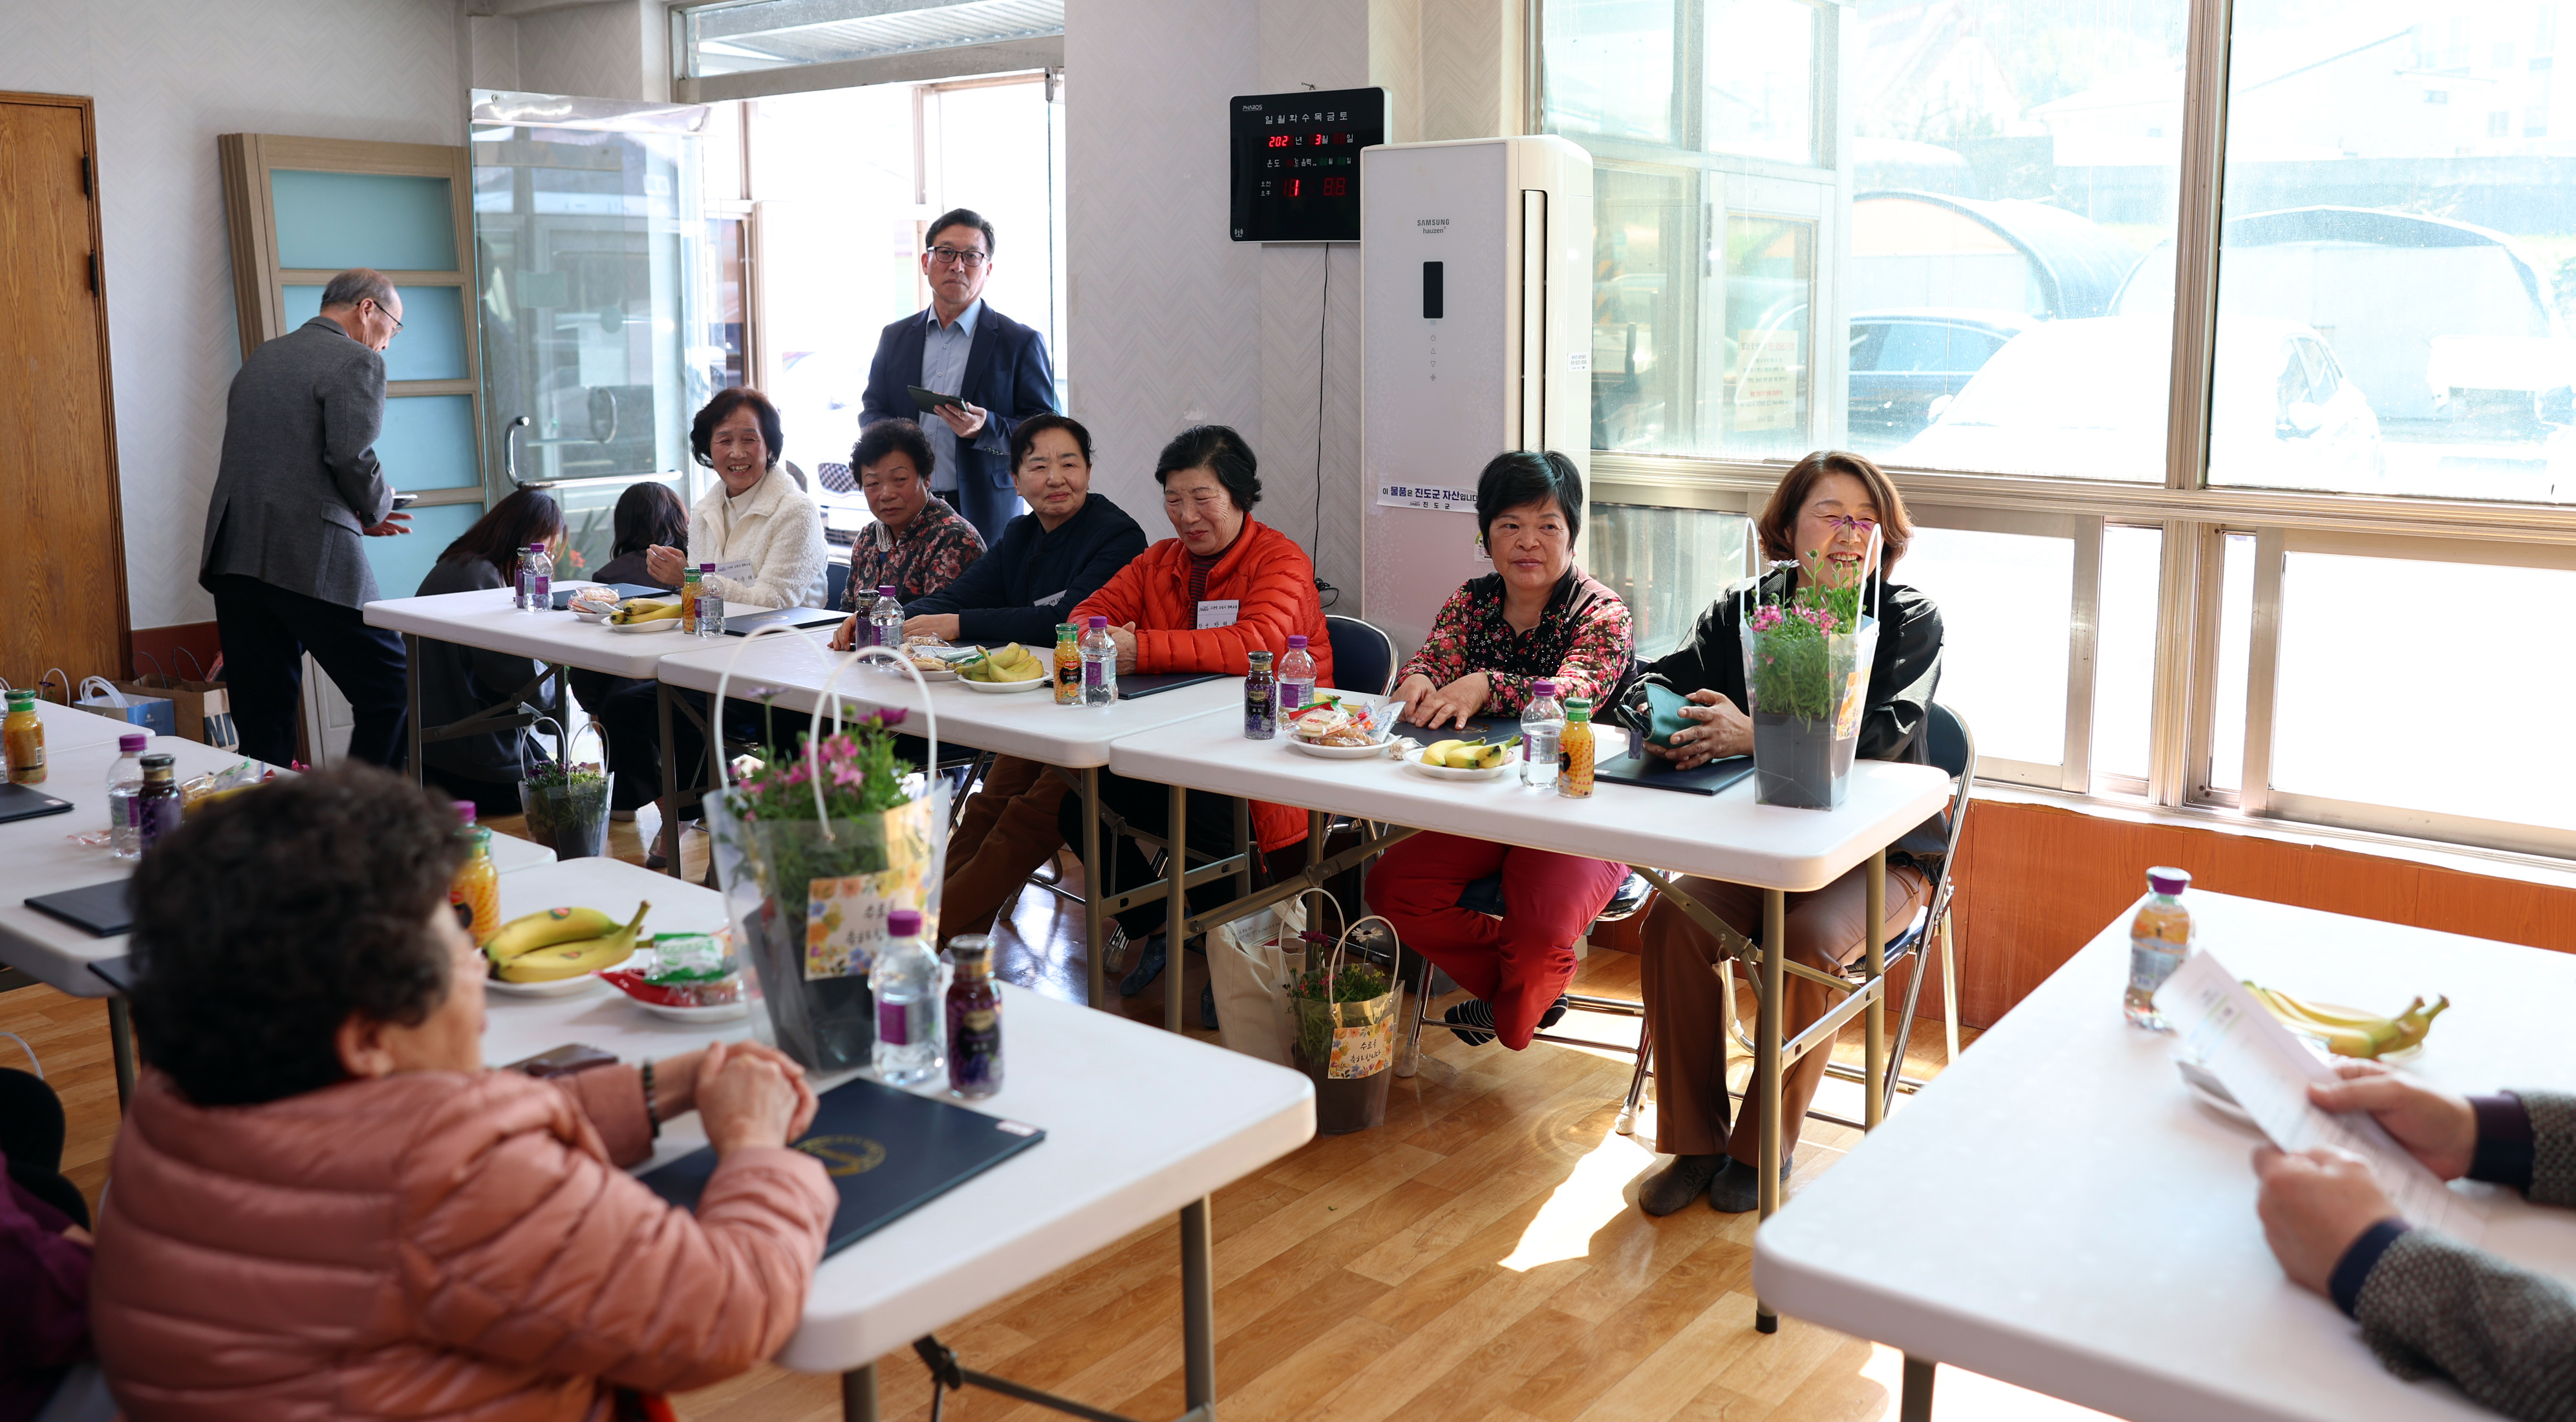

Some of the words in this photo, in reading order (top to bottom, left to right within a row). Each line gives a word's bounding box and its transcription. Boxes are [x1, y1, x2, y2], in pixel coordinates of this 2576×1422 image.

[1265, 115, 1272, 125] 일
[1277, 114, 1285, 124] 월
[1289, 114, 1298, 123] 화
[1302, 113, 1310, 123] 수
[1315, 112, 1322, 122] 목
[1327, 112, 1335, 122] 금
[1339, 111, 1348, 121] 토
[1295, 136, 1302, 145] 년
[1347, 134, 1353, 143] 일
[1390, 486, 1413, 497] 물품은
[1415, 488, 1440, 499] 진도군
[1360, 1038, 1377, 1051] 수료를
[1349, 1049, 1382, 1064] 축하합니다
